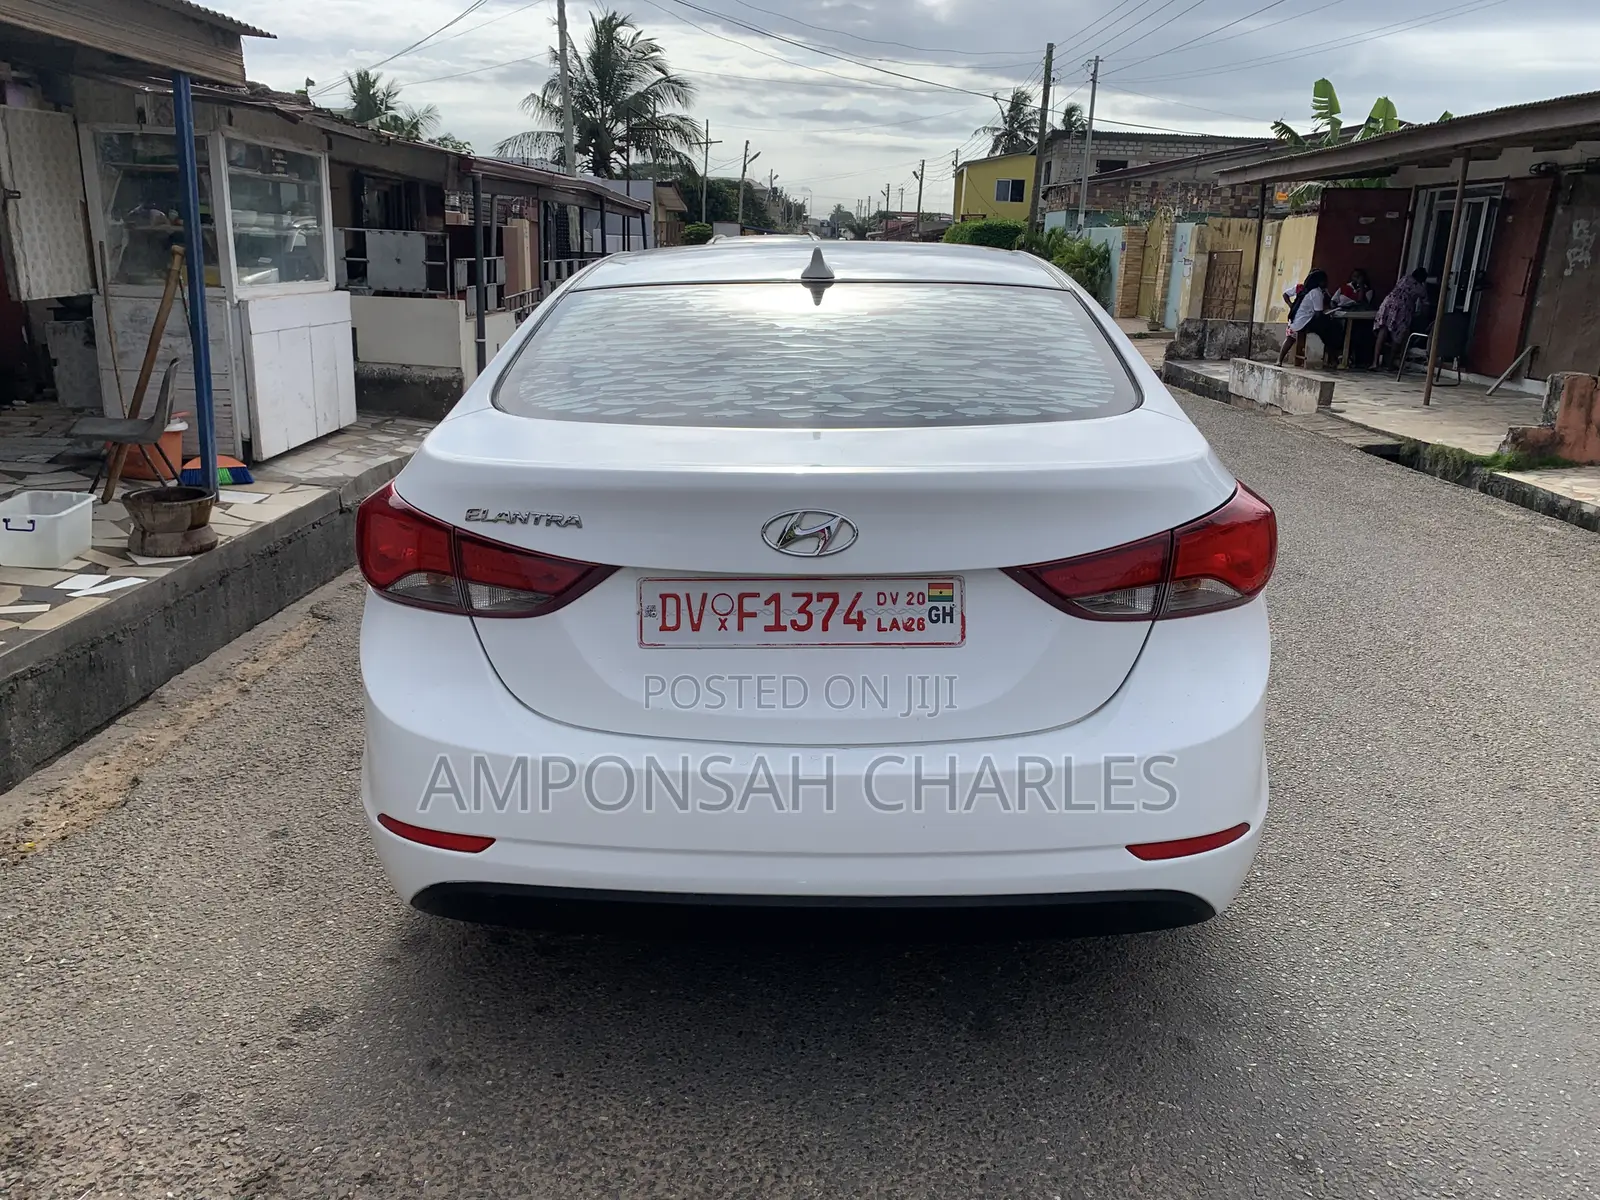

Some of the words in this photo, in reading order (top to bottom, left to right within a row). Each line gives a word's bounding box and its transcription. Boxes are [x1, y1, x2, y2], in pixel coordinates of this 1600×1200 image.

[465, 508, 583, 529] ELANTRA
[877, 591, 899, 606] DV
[906, 591, 926, 606] 20
[928, 605, 954, 624] GH
